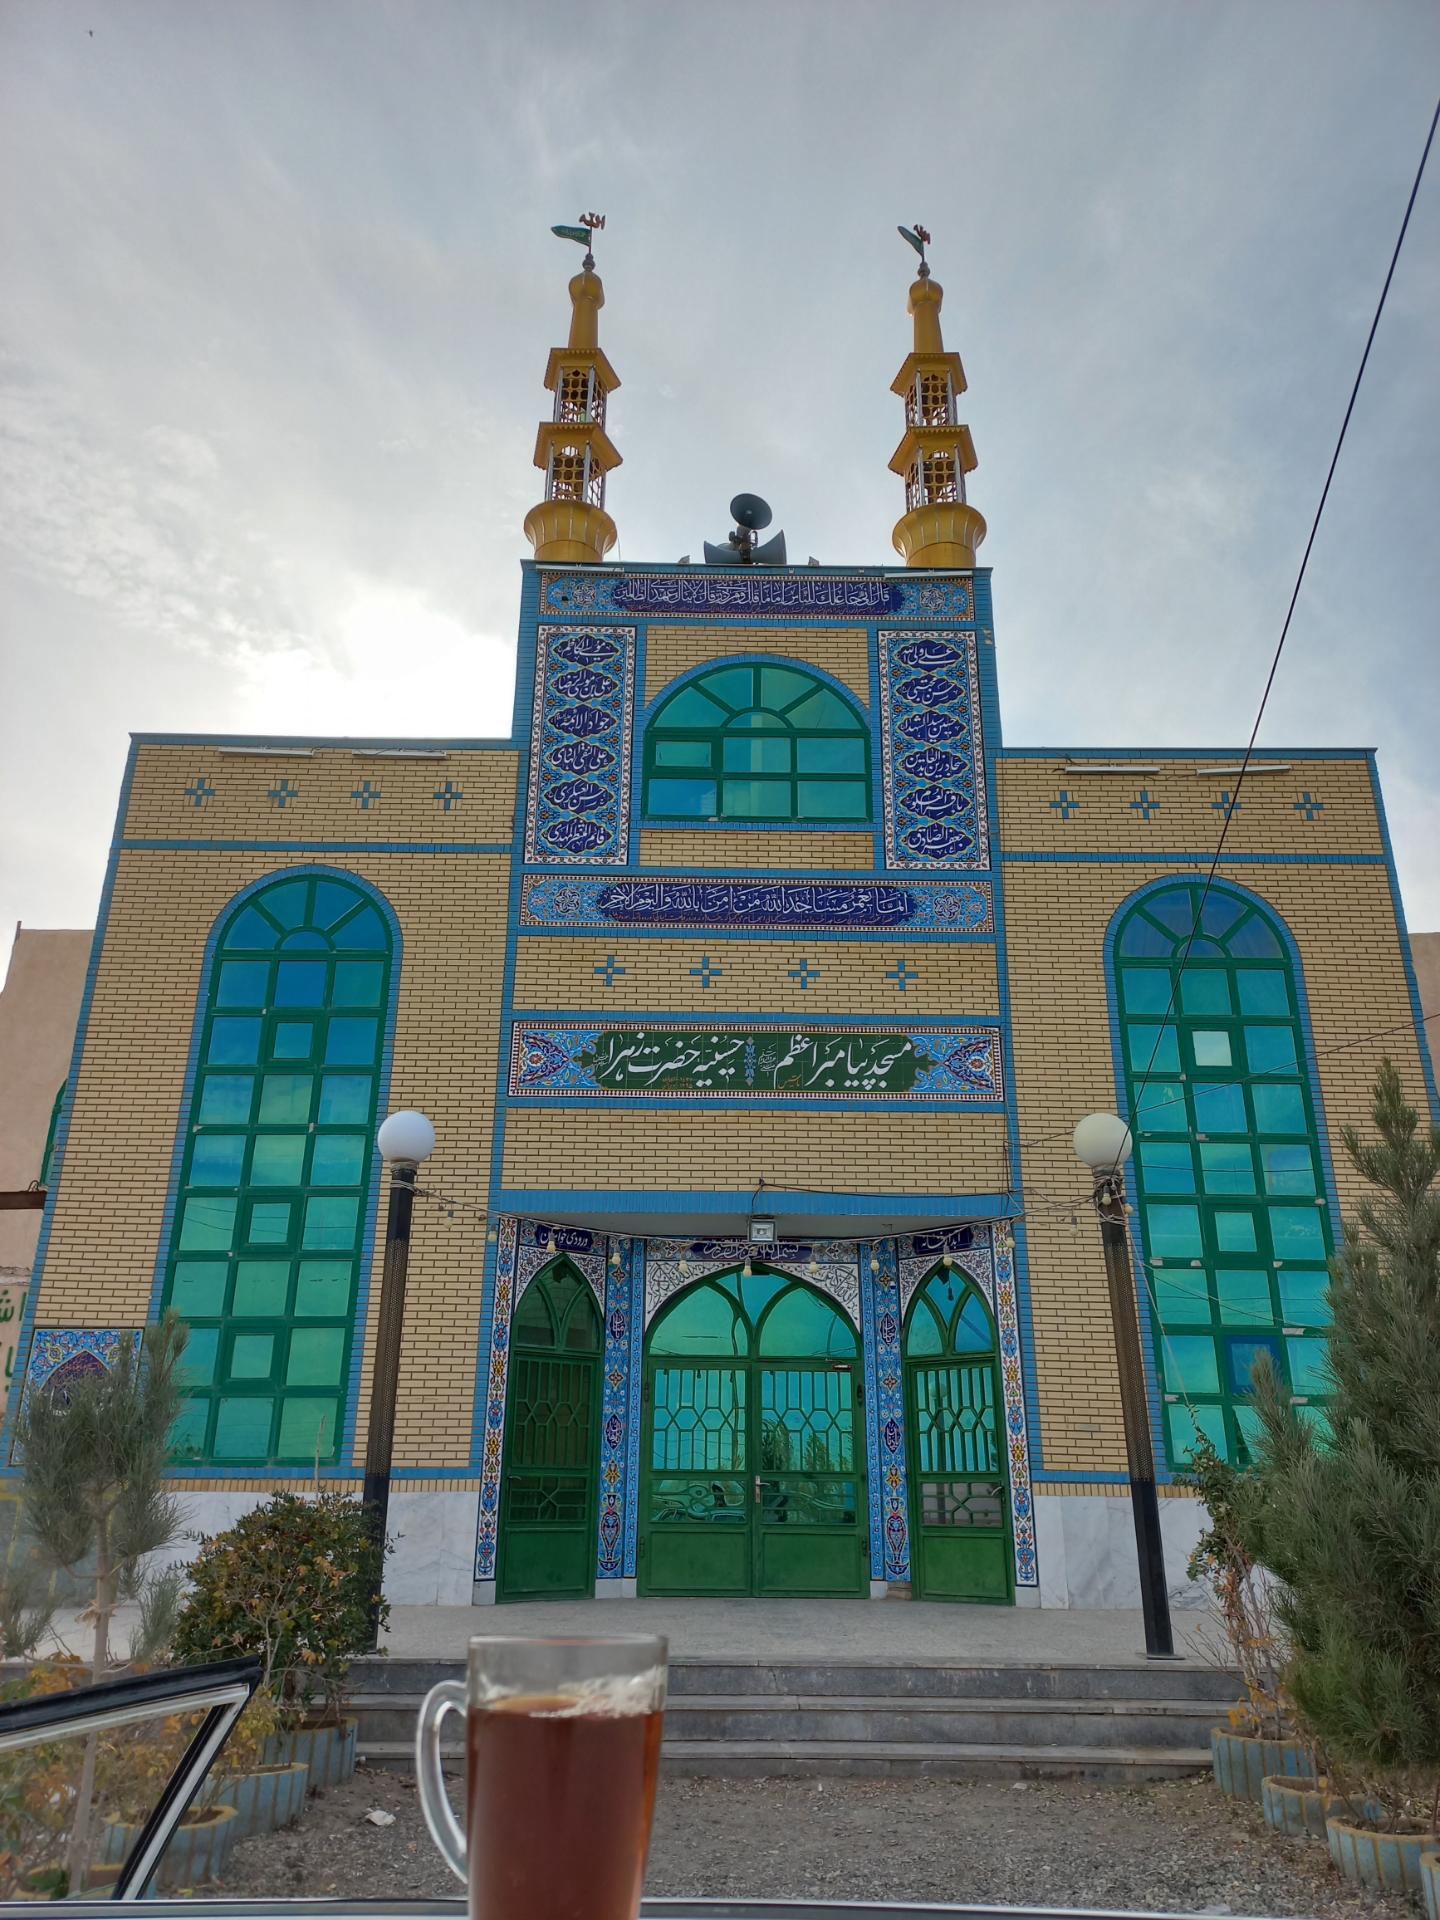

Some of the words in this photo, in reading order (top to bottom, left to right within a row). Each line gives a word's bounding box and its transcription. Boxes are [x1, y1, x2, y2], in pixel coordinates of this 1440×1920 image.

[762, 886, 786, 913] الله
[598, 1032, 645, 1082] زهرا
[628, 1038, 701, 1087] حضرت
[692, 1035, 745, 1088] حسینیه
[773, 1033, 819, 1090] اعظم
[804, 1036, 877, 1091] پیامبر
[863, 1038, 912, 1089] مسجد
[540, 1228, 566, 1245] خوان
[566, 1231, 588, 1247] ورودی
